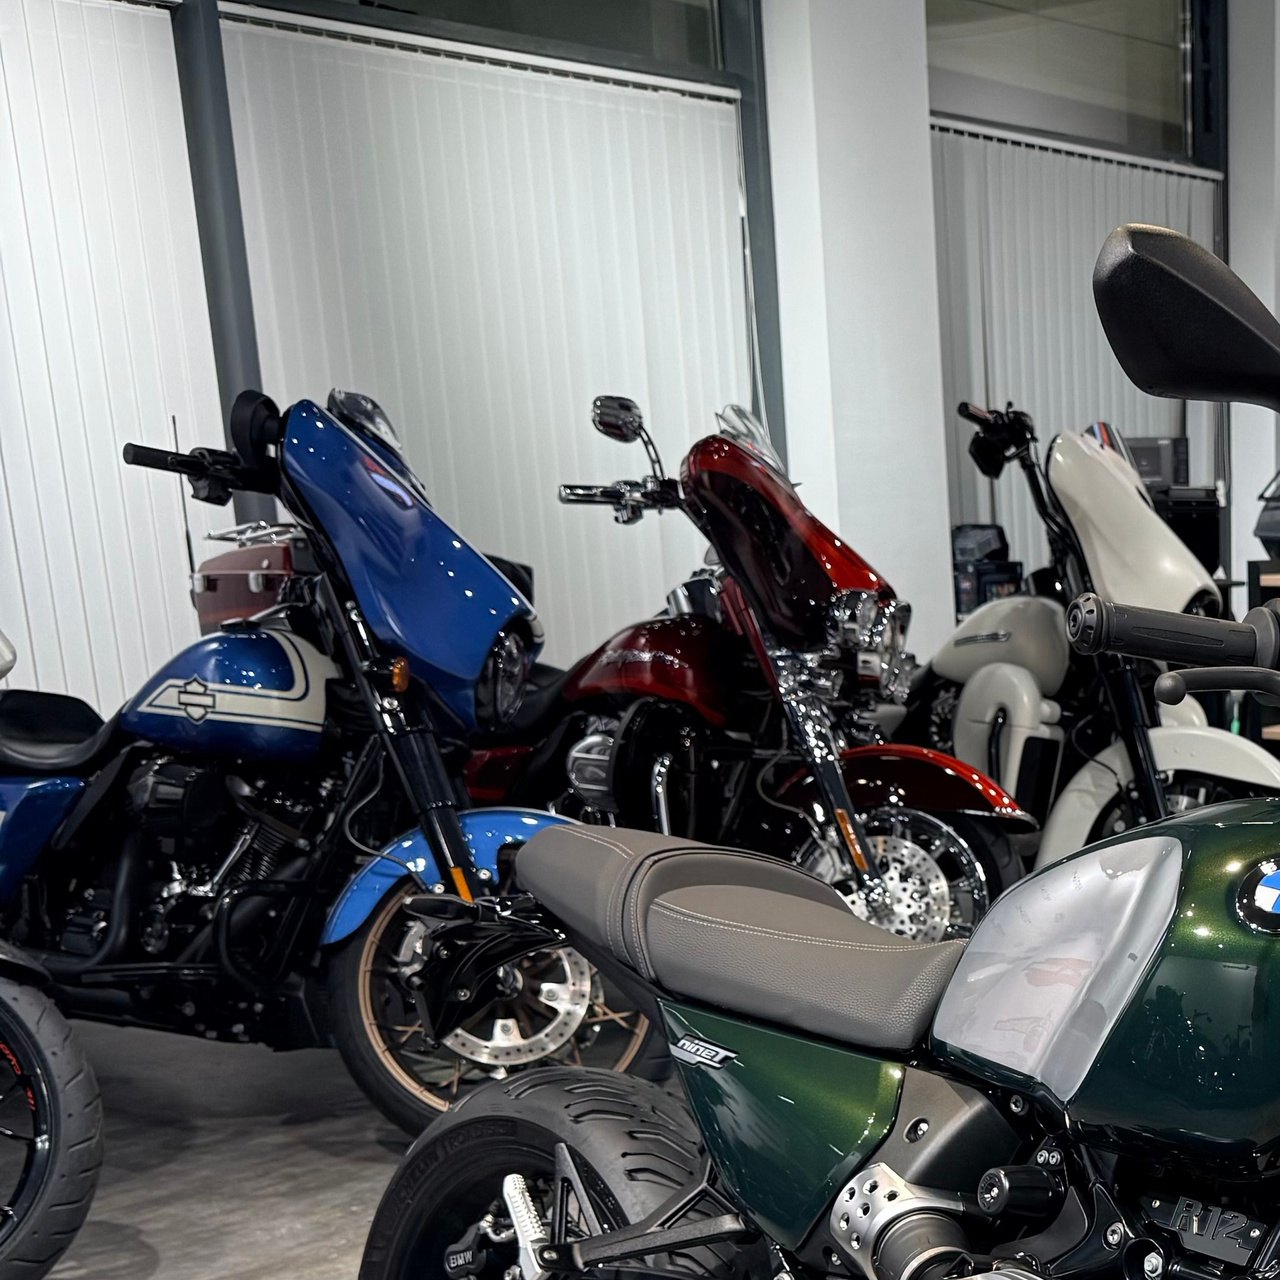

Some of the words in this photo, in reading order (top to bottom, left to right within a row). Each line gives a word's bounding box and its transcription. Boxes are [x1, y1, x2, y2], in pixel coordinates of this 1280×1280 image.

[677, 1039, 739, 1062] nineT
[1170, 1196, 1248, 1242] R12
[450, 1251, 473, 1268] BMW
